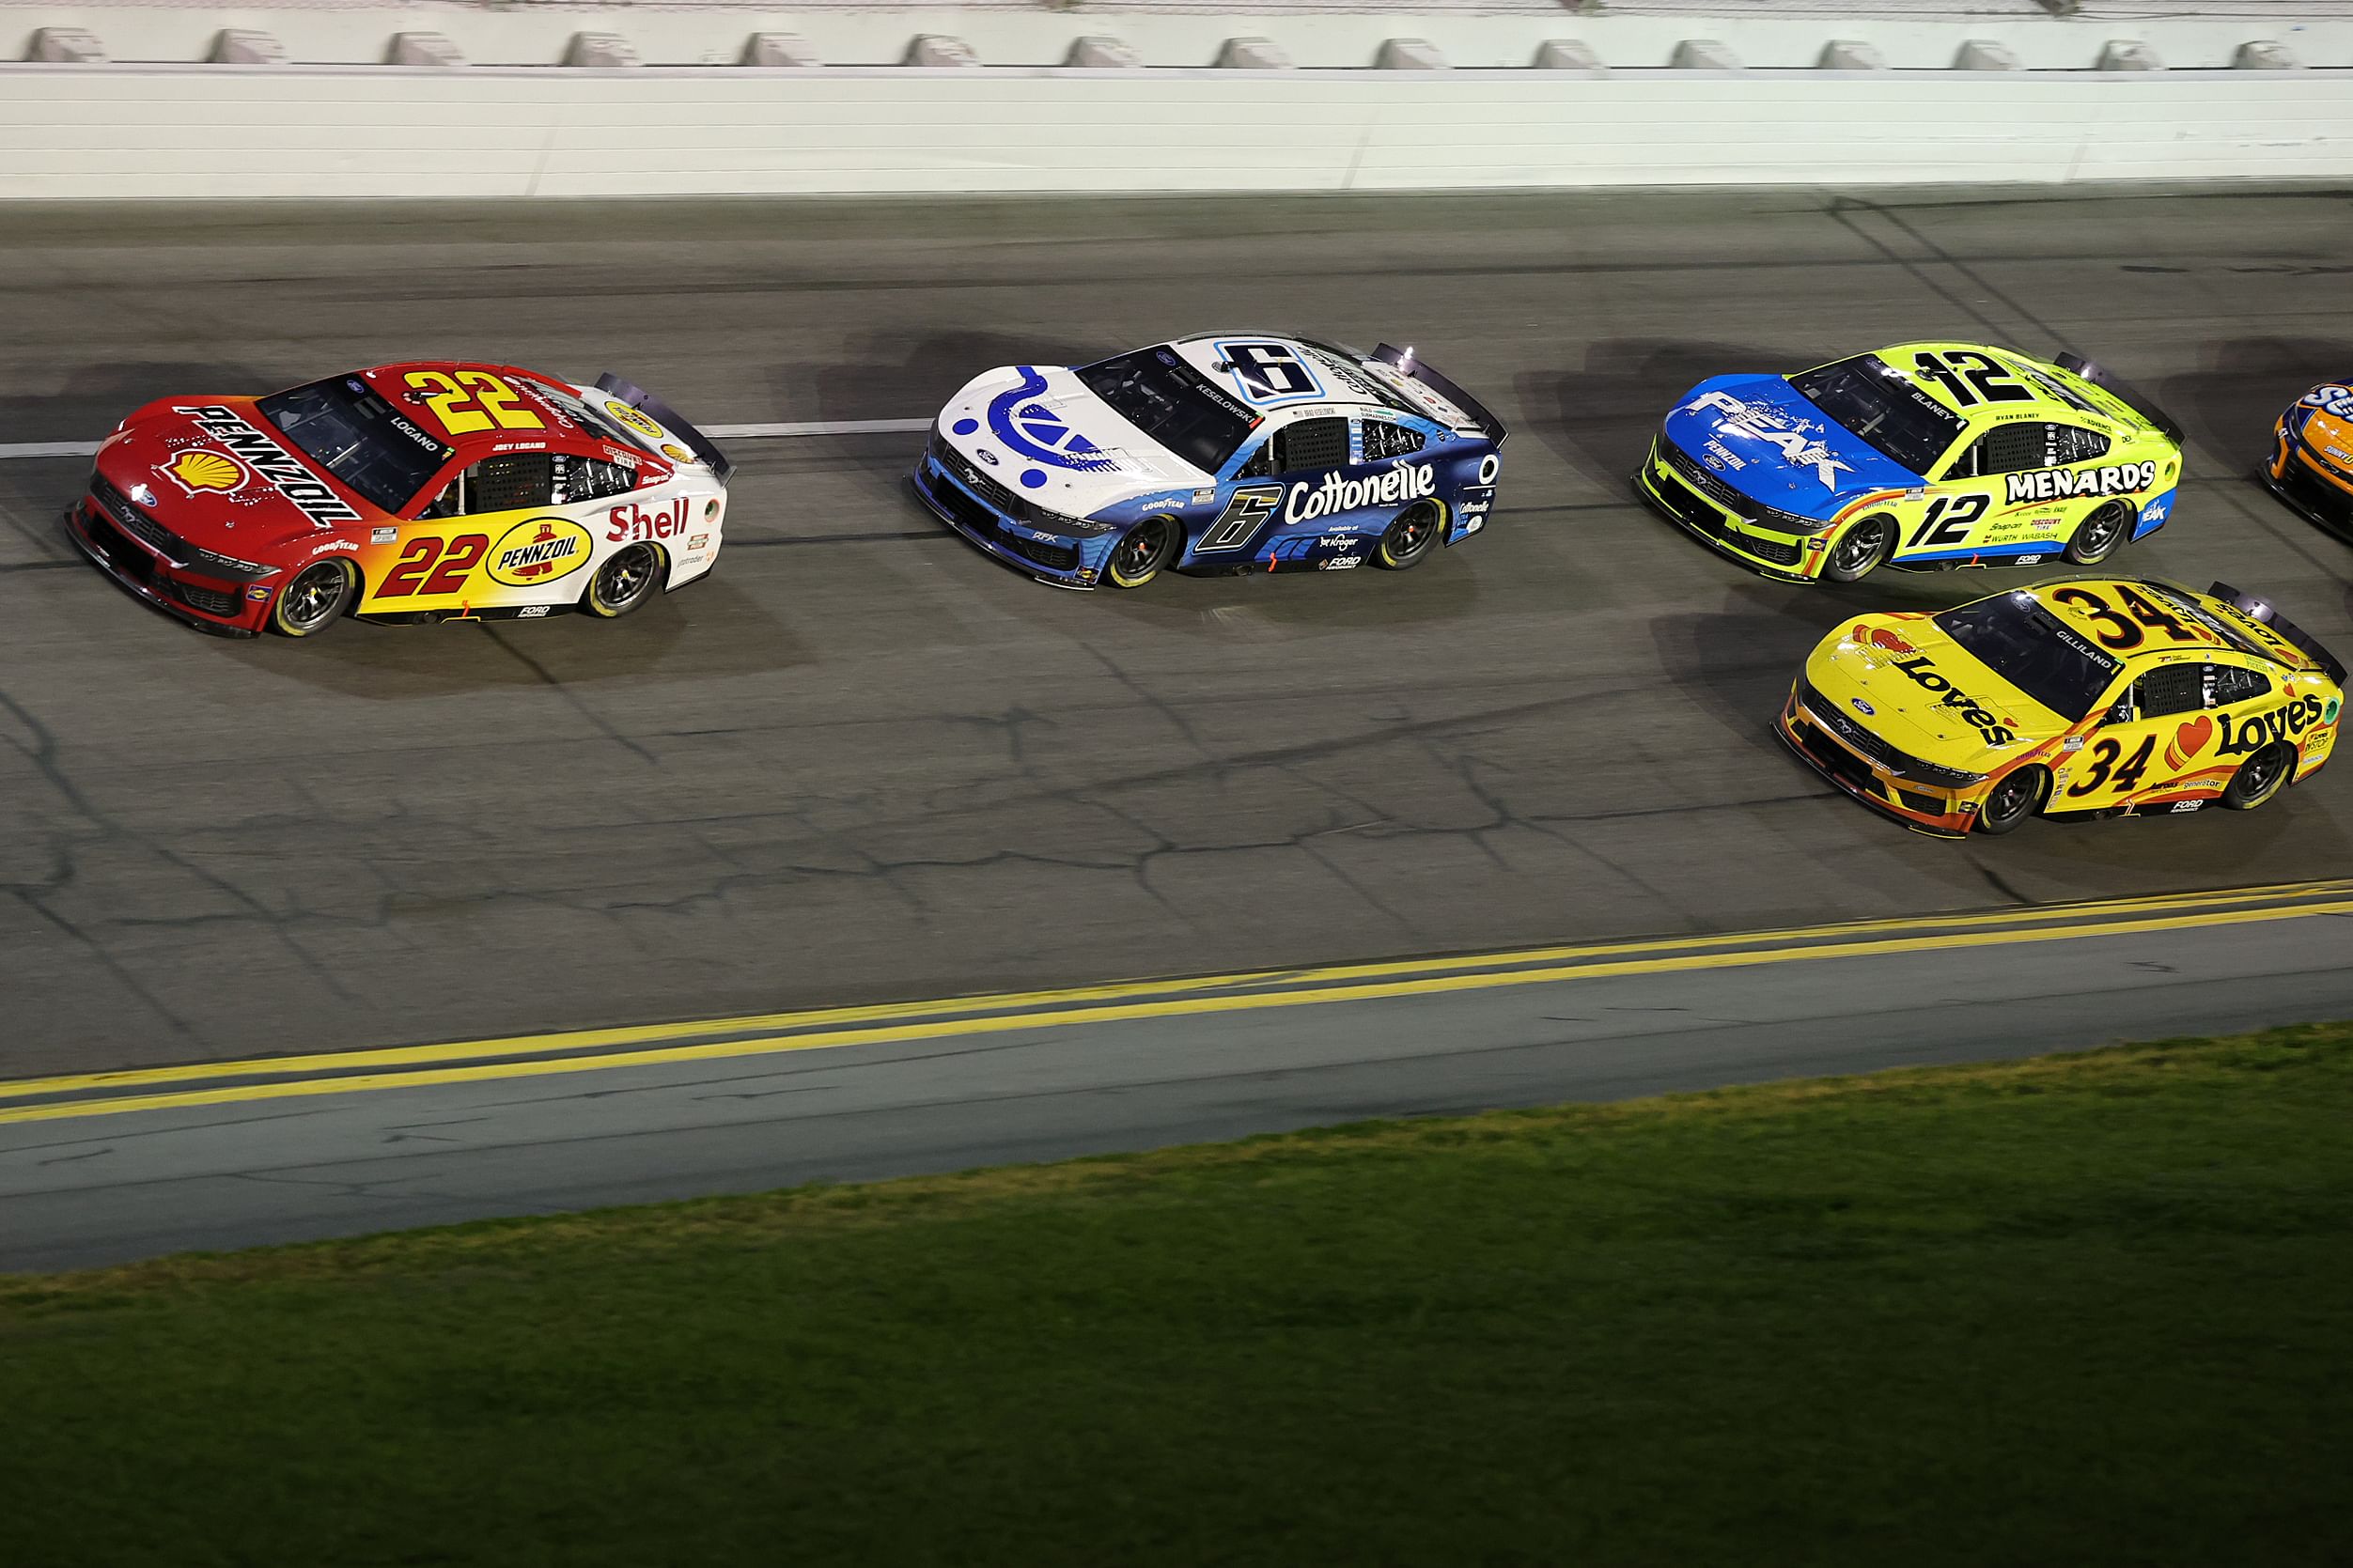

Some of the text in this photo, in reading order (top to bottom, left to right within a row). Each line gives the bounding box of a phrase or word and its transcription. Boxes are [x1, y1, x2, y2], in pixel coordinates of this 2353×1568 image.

[1913, 351, 2036, 406] 12
[402, 371, 547, 436] 22
[1195, 383, 1254, 425] KESELOWSKI
[1910, 391, 1956, 422] BLANEY
[389, 416, 439, 453] LOGANO
[515, 442, 547, 450] LOGANO
[172, 405, 364, 529] PENNZOIL
[977, 449, 998, 466] Ford
[1704, 440, 1748, 471] PENNZOIL
[1284, 458, 1437, 526] Cottonelle
[2004, 460, 2157, 506] MENARDS
[605, 496, 690, 542] Shell
[1142, 498, 1185, 511] GOODYEAR
[1194, 487, 1282, 552] 6
[1906, 495, 1991, 549] 12
[312, 539, 359, 555] GOODYEAR
[497, 536, 577, 570] PENNZOIL
[1032, 532, 1059, 543] RFK
[1330, 534, 1359, 551] Kroger
[2022, 532, 2059, 540] WABASH
[372, 534, 490, 599] 22
[1329, 557, 1361, 566] FORD
[520, 606, 550, 614] FORD
[2052, 584, 2199, 650] 34
[2056, 630, 2112, 669] GILLILAND
[1853, 699, 1874, 716] Ford
[2066, 733, 2158, 798] 34
[2174, 800, 2204, 809] FORD
